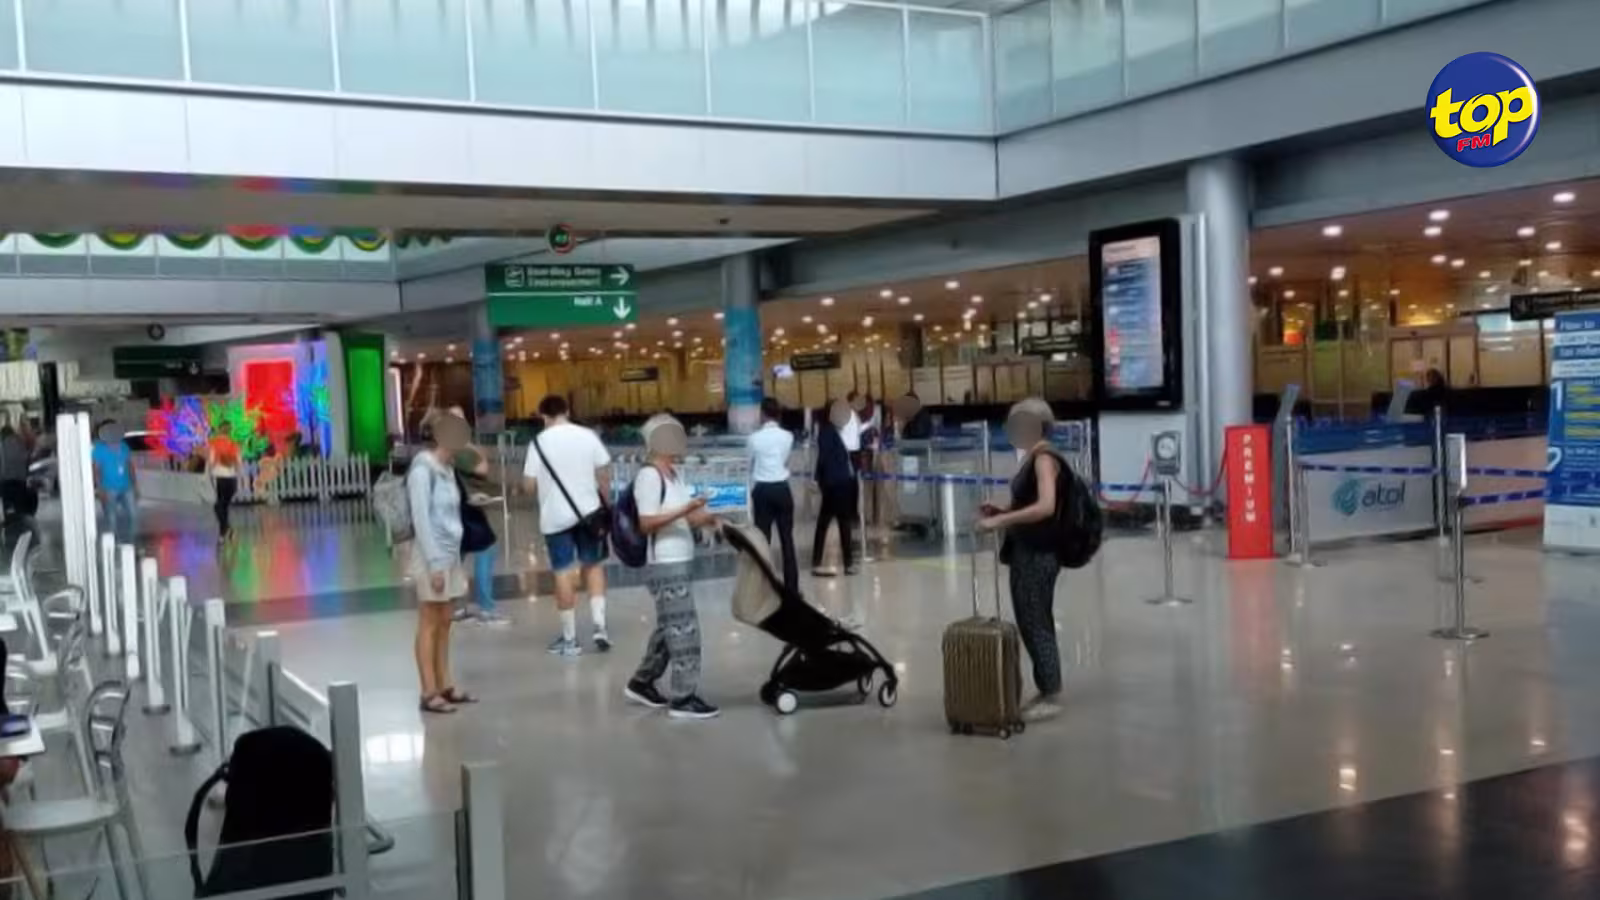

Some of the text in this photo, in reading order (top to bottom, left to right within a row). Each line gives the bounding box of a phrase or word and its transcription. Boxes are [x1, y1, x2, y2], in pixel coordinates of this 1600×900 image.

[594, 296, 603, 306] A
[1551, 380, 1563, 411] 1
[1242, 433, 1256, 522] PREMIUM
[1362, 479, 1406, 507] atol
